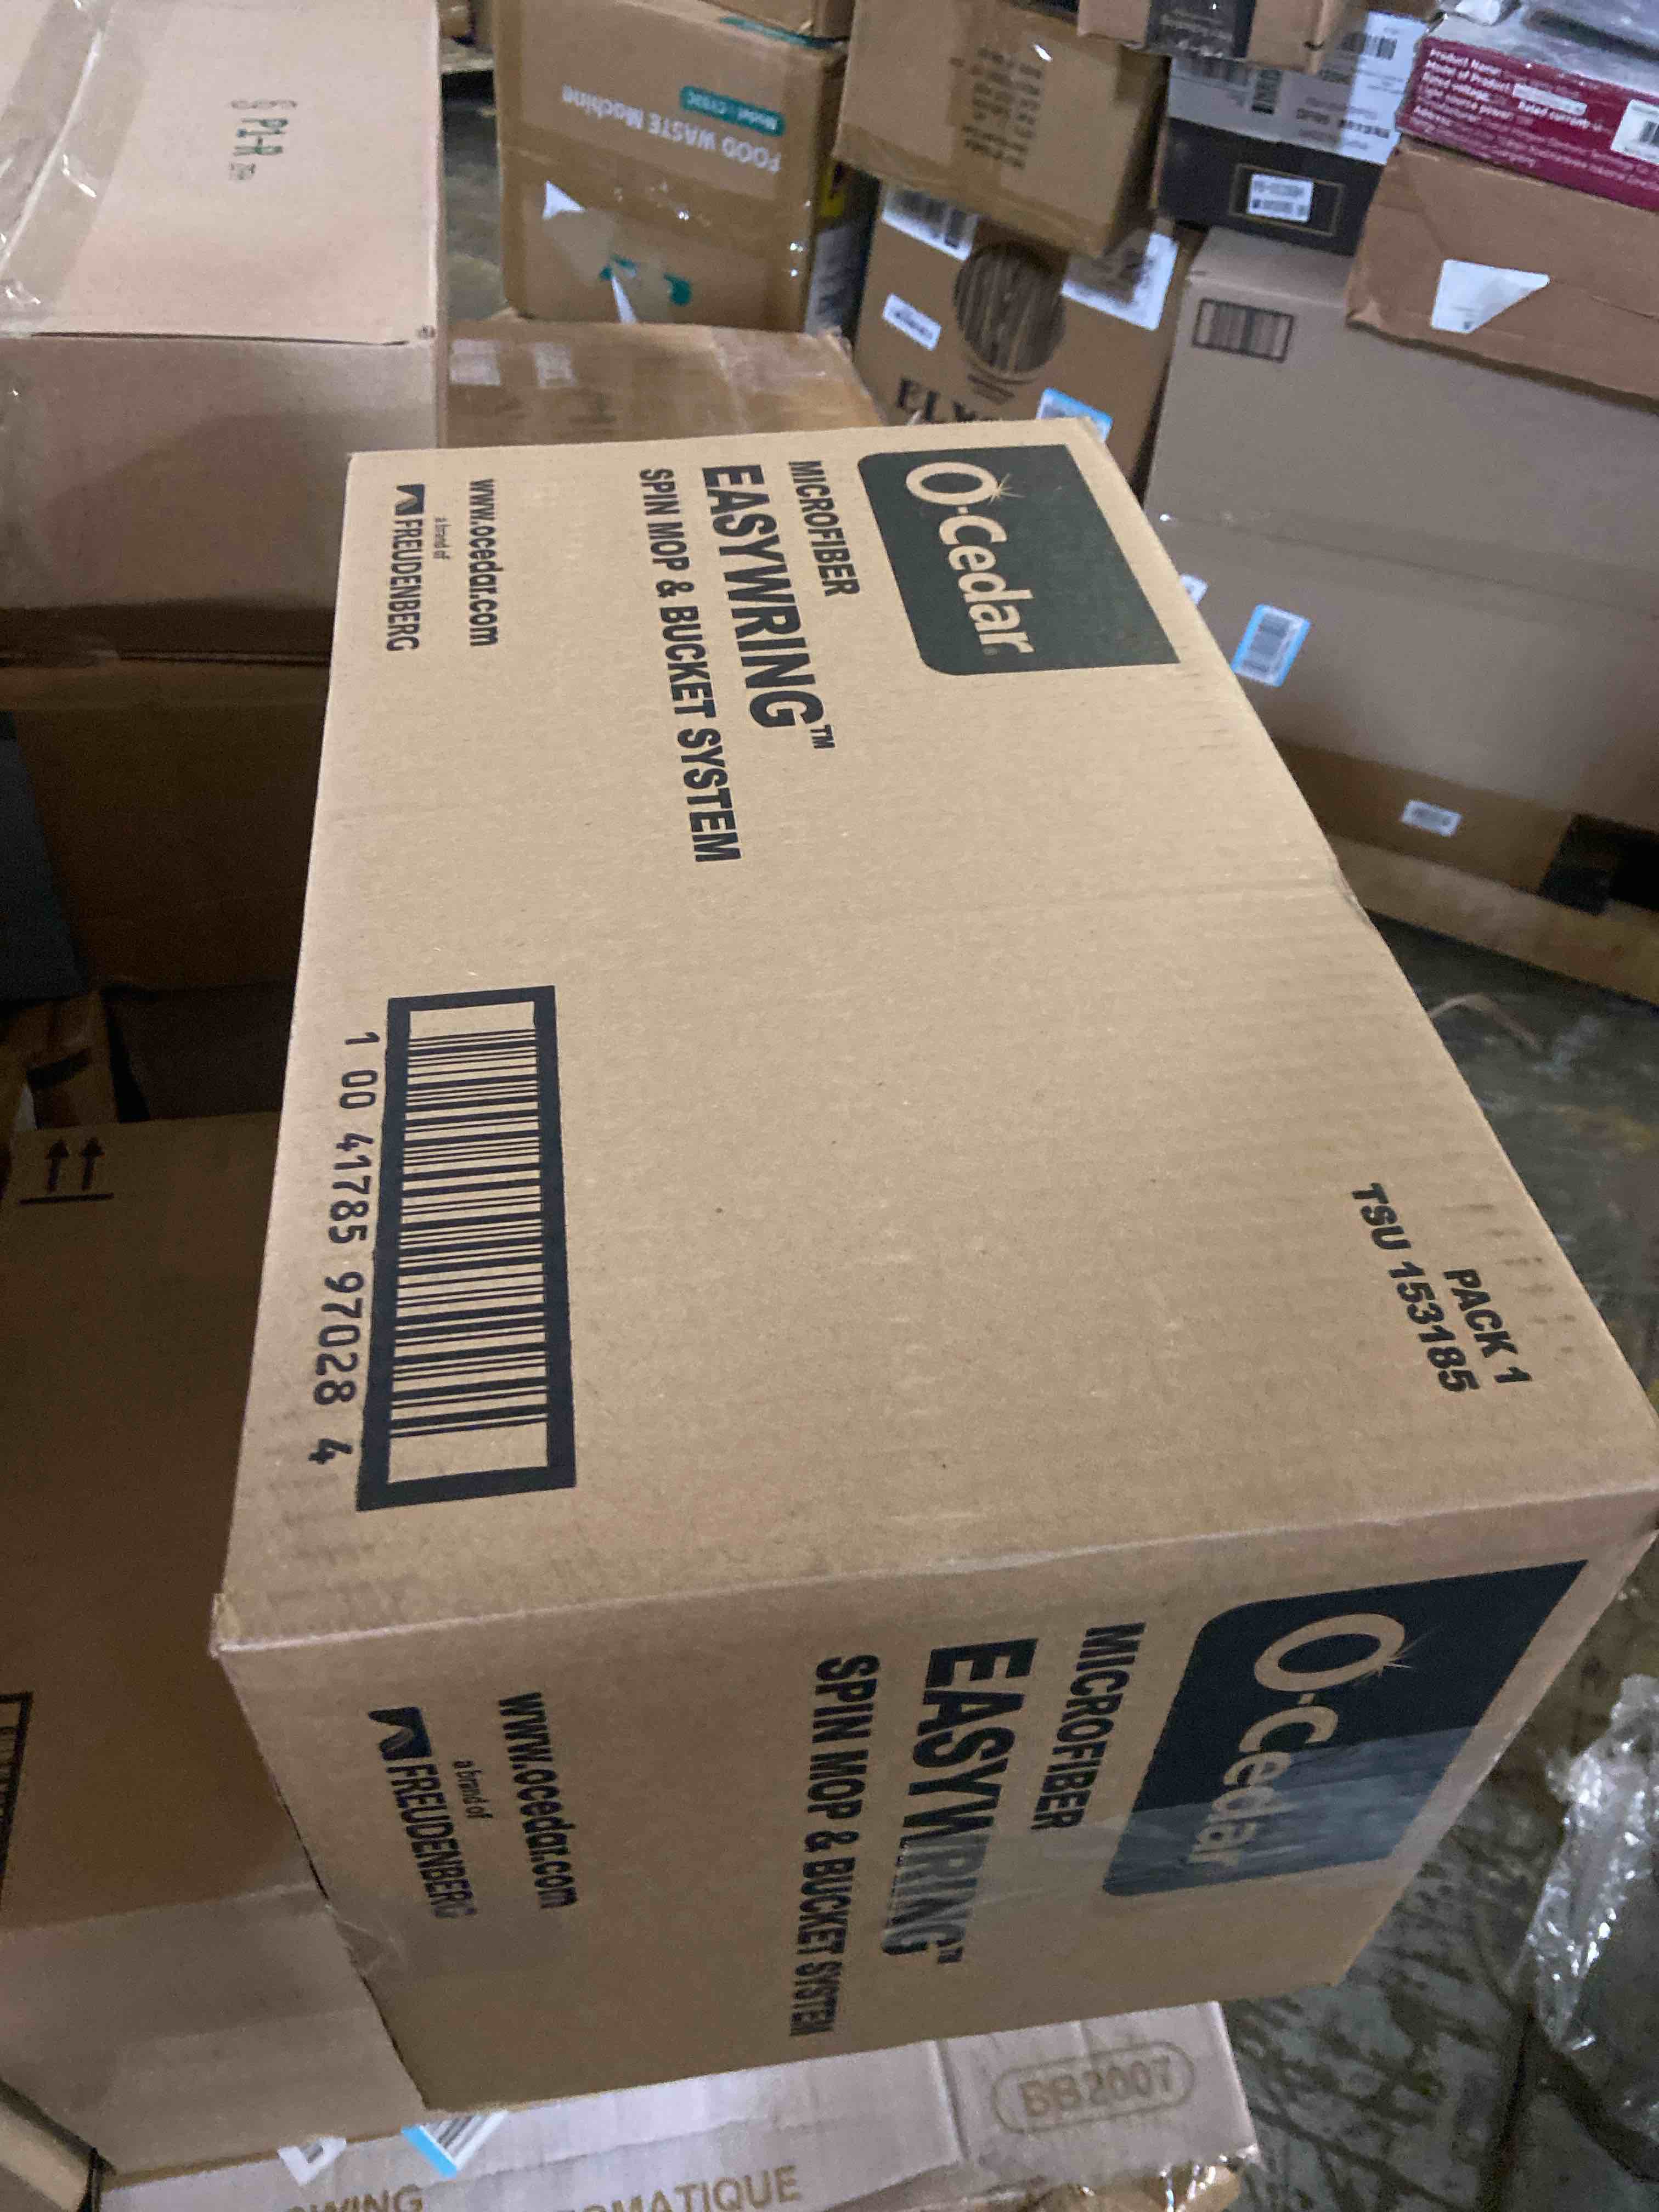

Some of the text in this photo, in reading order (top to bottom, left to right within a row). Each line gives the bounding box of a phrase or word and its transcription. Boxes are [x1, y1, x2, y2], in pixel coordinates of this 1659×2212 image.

[562, 83, 645, 130] Machine
[647, 112, 716, 151] WASTE
[720, 136, 782, 174] FOOD
[386, 518, 424, 651] FREUDENBERG
[469, 478, 504, 647] www.ocedar.com
[788, 460, 861, 597] MICROFIBER
[639, 469, 742, 862] SPIN MOP & BUCKET SYSTEM
[307, 1031, 381, 1465] 1 00 41785 97028 4
[1351, 1182, 1481, 1392] TSU 153185
[1443, 1268, 1533, 1384] PACK 1
[456, 1769, 490, 1804] brand
[498, 1691, 577, 1910] www.ocedar.com
[1030, 1622, 1147, 1831] MICROFIBER
[385, 1763, 478, 1918] FREUDENBERG
[789, 1653, 881, 2038] SPIN MOP & BUCKET SYSTEM
